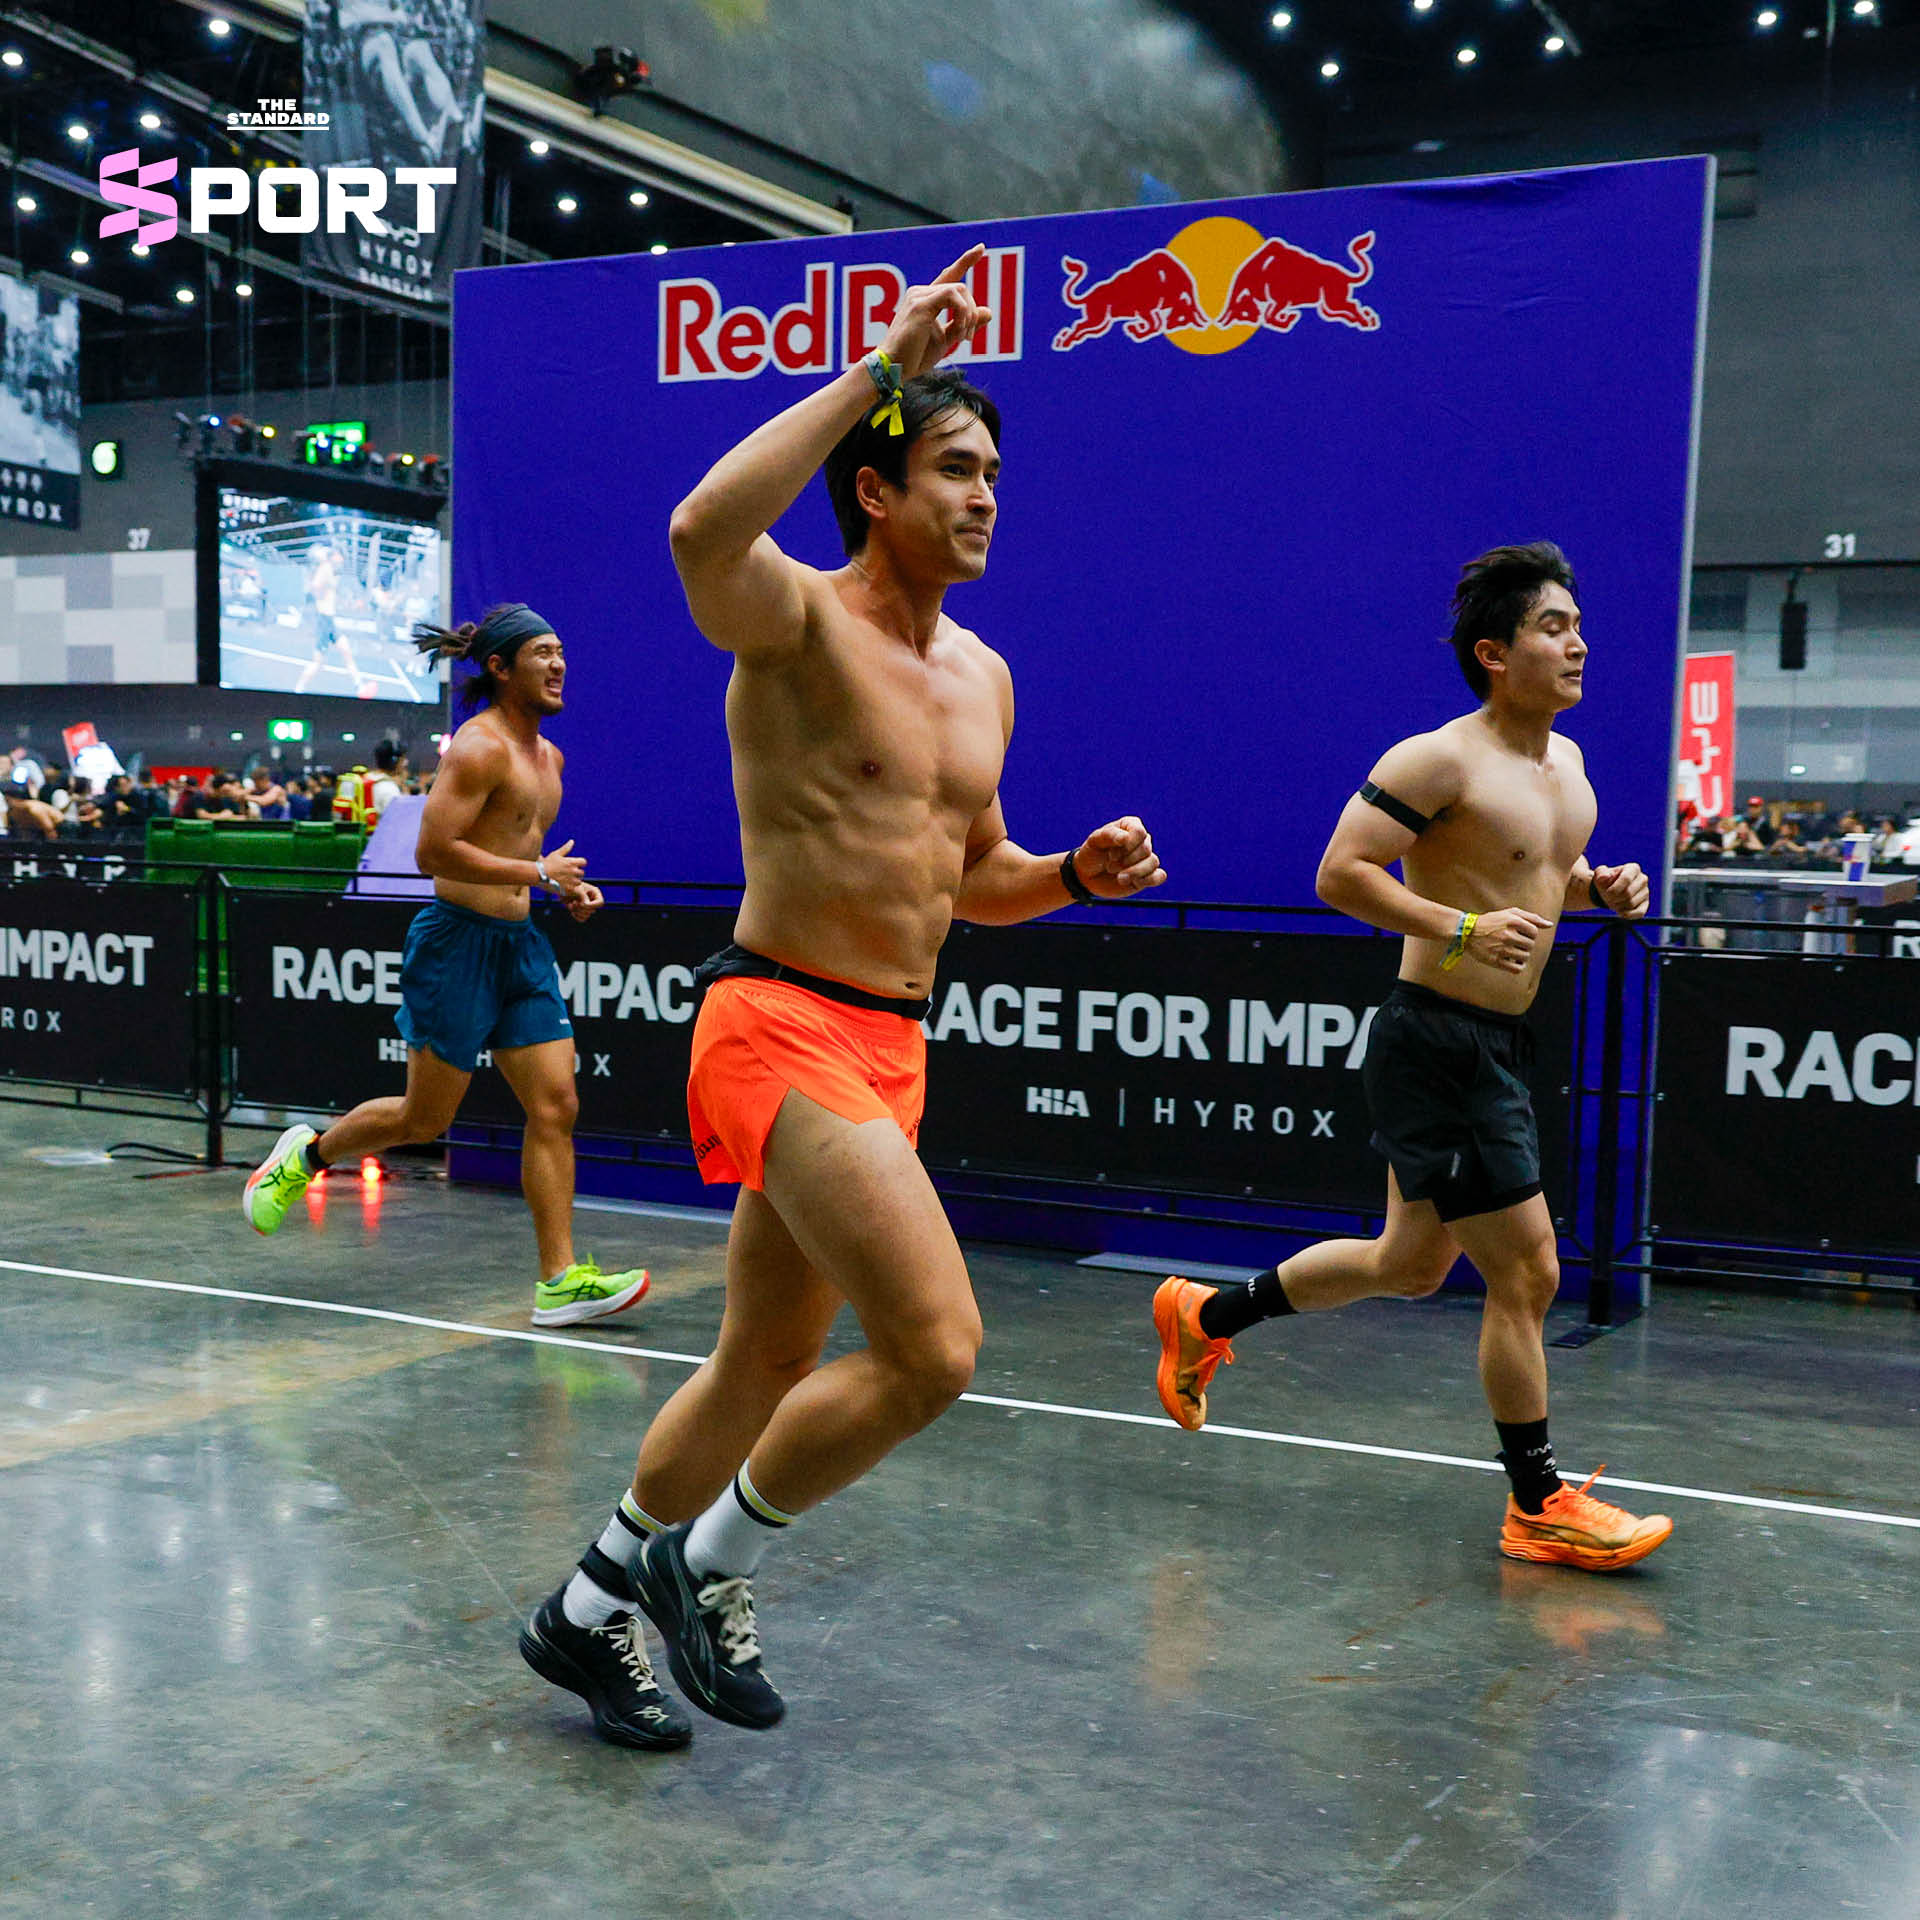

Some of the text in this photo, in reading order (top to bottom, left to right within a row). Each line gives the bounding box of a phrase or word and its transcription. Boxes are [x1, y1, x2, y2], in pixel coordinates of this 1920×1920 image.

[359, 239, 433, 279] HYROX
[660, 249, 1022, 381] Red Bll
[127, 527, 150, 551] 37
[1823, 532, 1857, 559] 31
[0, 927, 154, 987] IMPACT
[272, 945, 697, 1024] RACE MPAC
[919, 981, 1062, 1051] ACE
[1077, 989, 1211, 1061] FOR
[1725, 1025, 1920, 1108] RAC
[1153, 1097, 1336, 1138] HYROX
